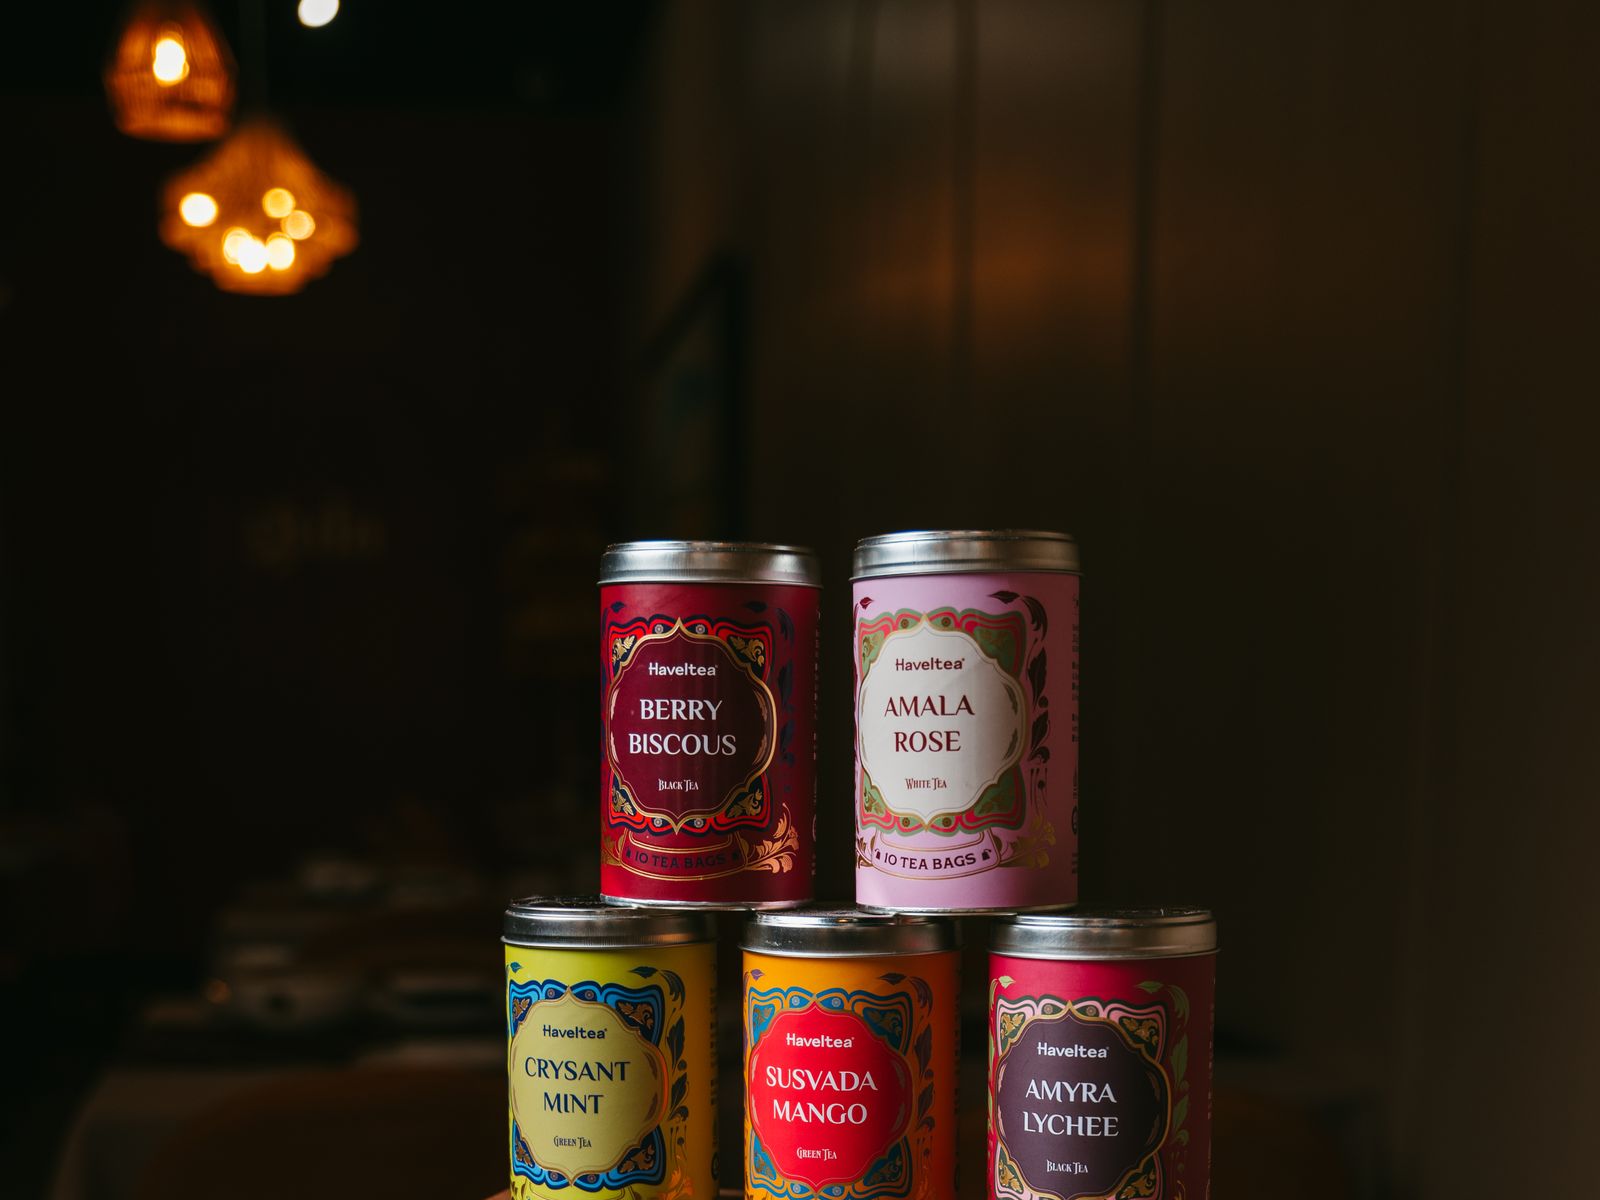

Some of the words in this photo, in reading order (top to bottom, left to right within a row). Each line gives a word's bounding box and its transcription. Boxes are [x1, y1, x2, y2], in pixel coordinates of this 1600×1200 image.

[648, 663, 717, 676] Haveltea
[895, 658, 964, 671] Haveltea
[640, 699, 722, 721] BERRY
[884, 695, 975, 717] AMALA
[628, 734, 736, 756] BISCOUS
[894, 730, 961, 752] ROSE
[652, 855, 678, 870] TEA
[684, 854, 726, 869] BAGS
[900, 856, 928, 870] TEA
[933, 853, 976, 869] BAGS
[543, 1025, 606, 1039] Haveltea
[786, 1033, 853, 1048] Haveltea
[1037, 1042, 1108, 1058] Haveltea
[525, 1056, 630, 1081] CRYSANT
[766, 1066, 878, 1091] SUSVADA
[1025, 1080, 1117, 1103] AMYRA
[544, 1092, 604, 1114] MINT
[773, 1100, 867, 1124] MANGO
[1023, 1111, 1119, 1137] LYCHEE
